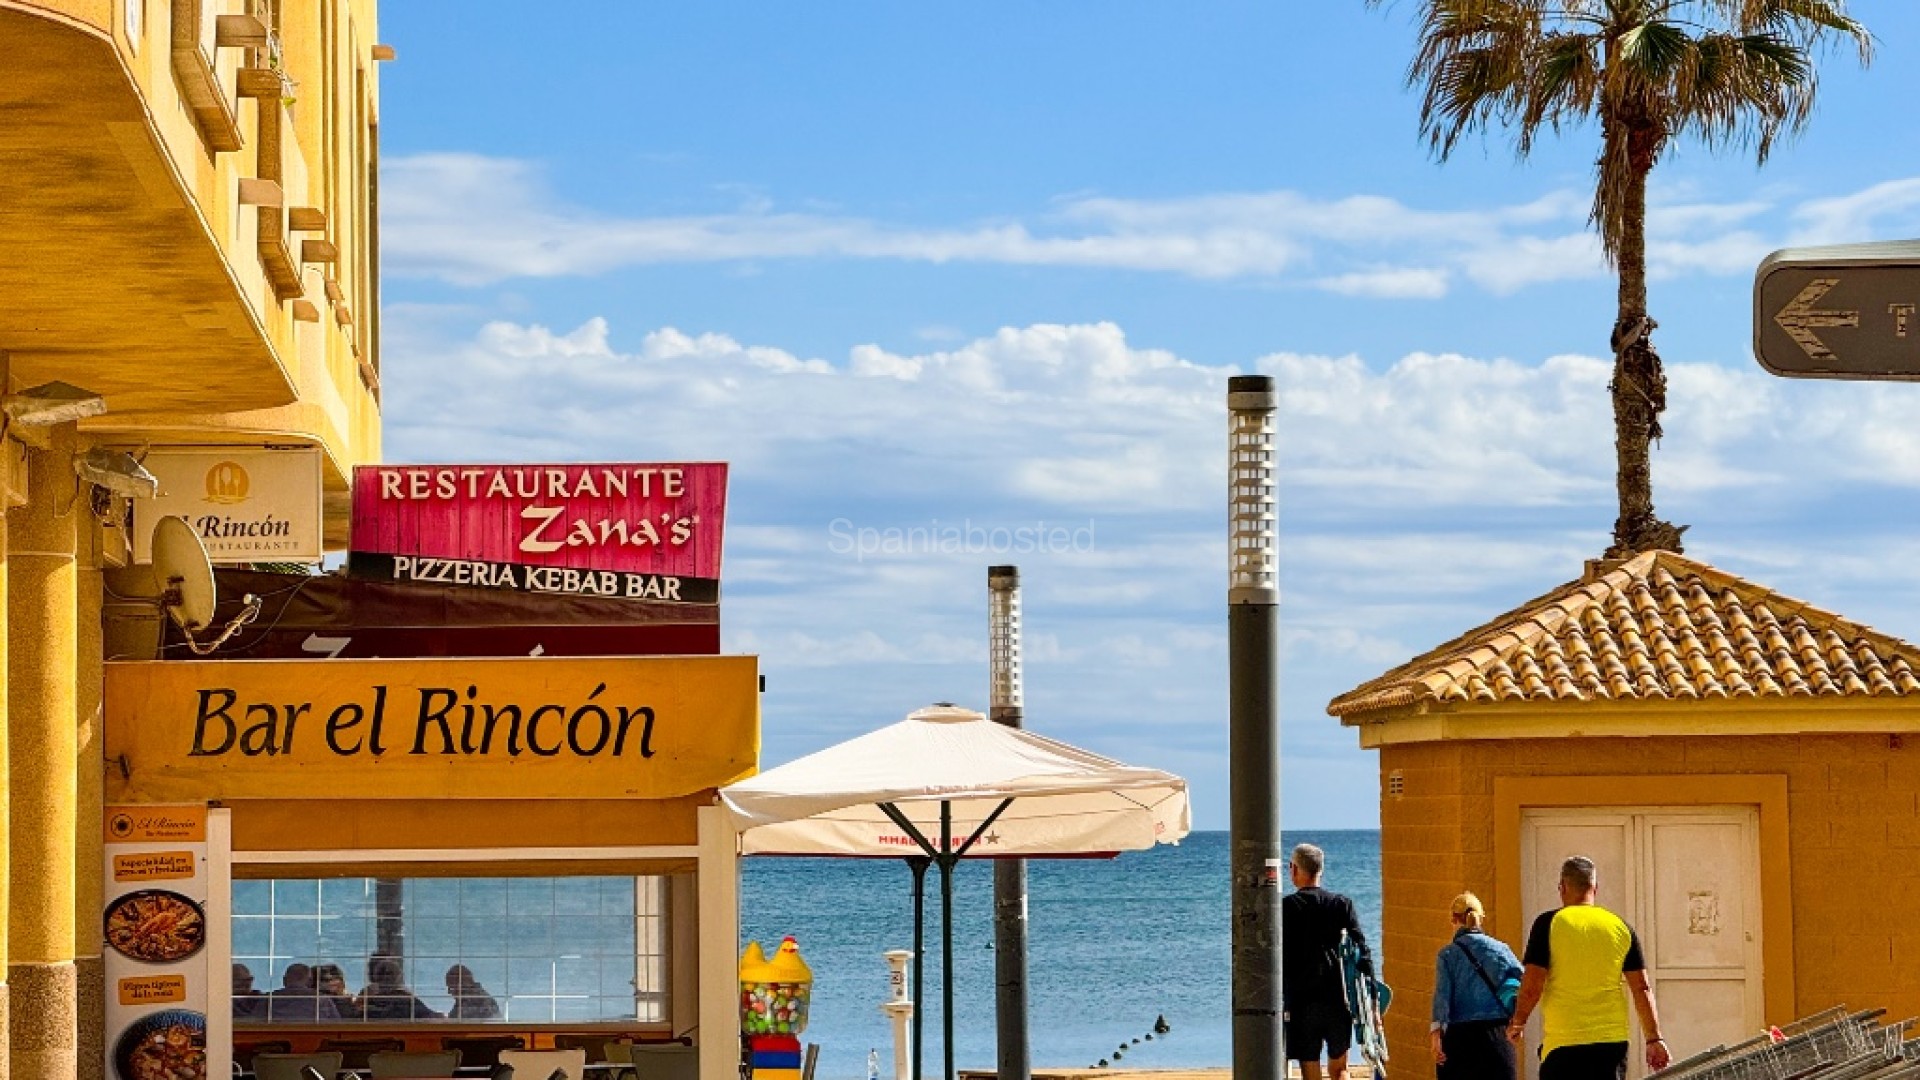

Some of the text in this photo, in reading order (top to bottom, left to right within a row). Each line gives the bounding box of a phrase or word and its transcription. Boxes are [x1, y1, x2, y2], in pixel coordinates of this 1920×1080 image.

[379, 469, 686, 499] RESTAURANTE
[196, 513, 290, 538] Rincón
[519, 504, 692, 552] Zana's
[393, 556, 682, 600] PIZZERIA KEBAB BAR
[187, 682, 657, 758] Bar el Rincón
